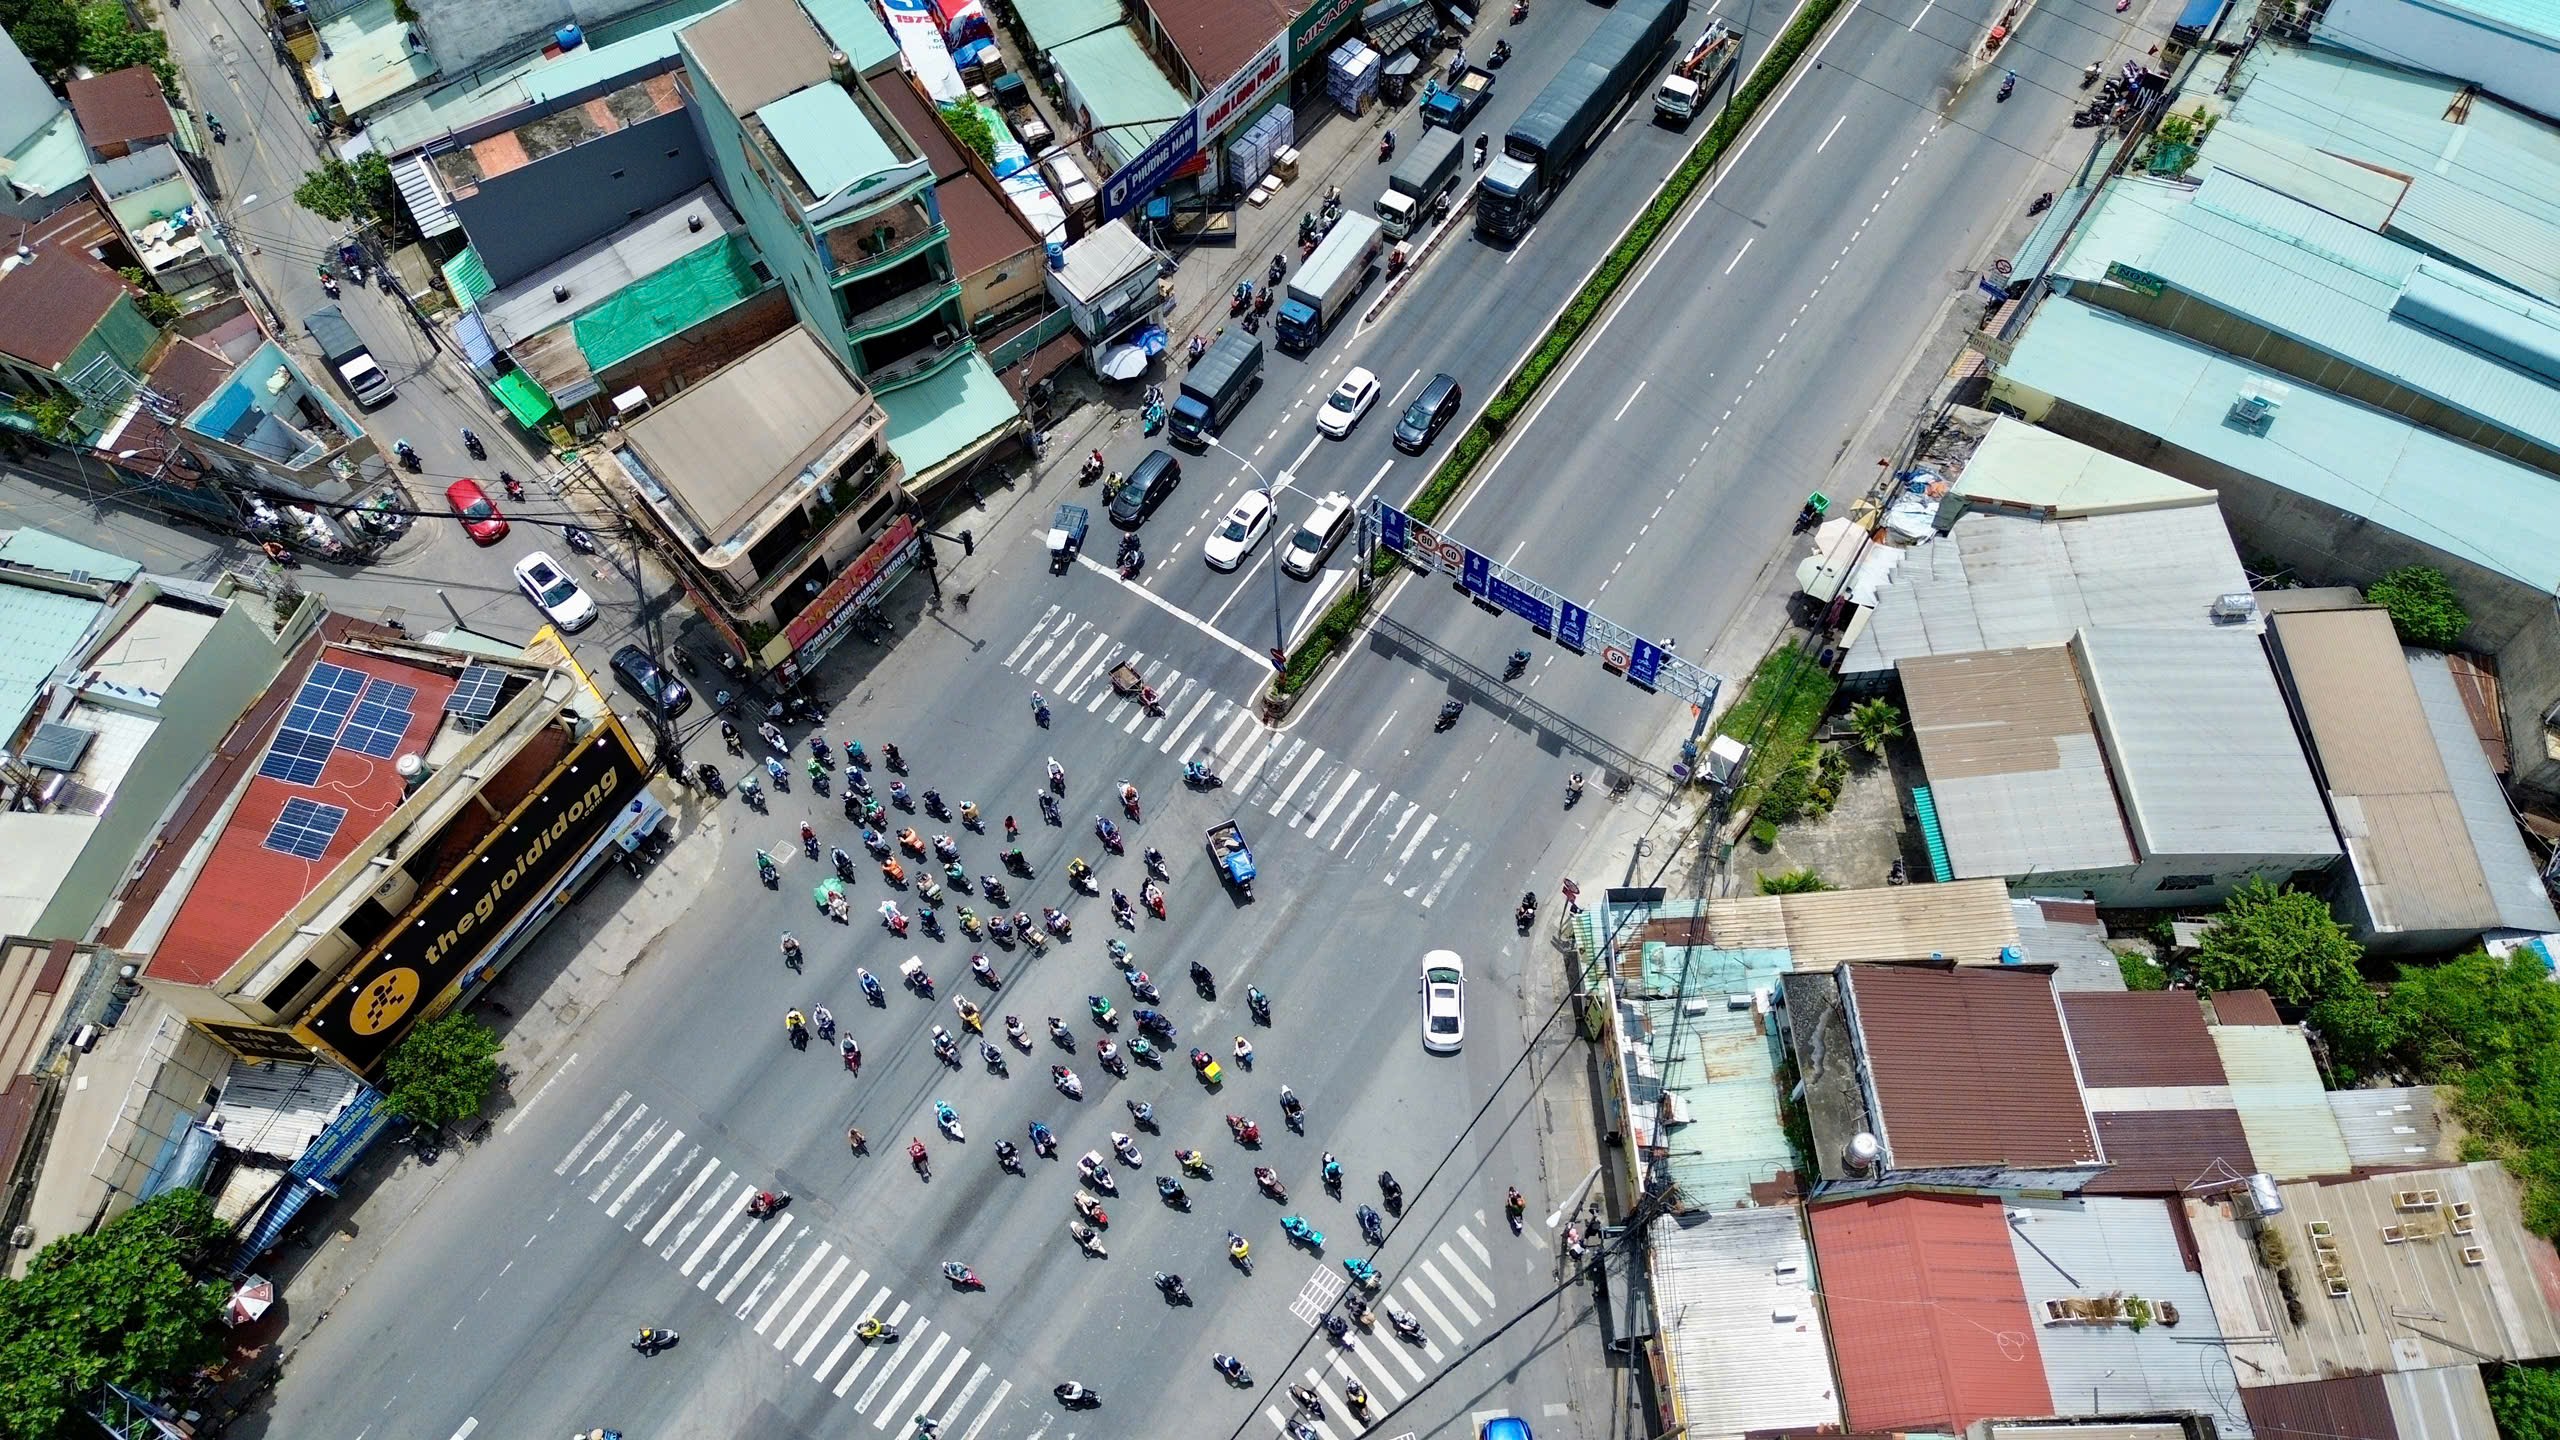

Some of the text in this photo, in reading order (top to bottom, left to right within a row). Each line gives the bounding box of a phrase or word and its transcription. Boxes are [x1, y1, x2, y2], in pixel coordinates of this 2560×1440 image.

[1171, 125, 1194, 154] NAM
[1421, 535, 1433, 547] 80
[1445, 549, 1457, 561] 60
[855, 573, 883, 605] QUANG
[883, 551, 908, 578] HƯNG
[1610, 652, 1623, 665] 50
[581, 796, 603, 820] .com
[424, 766, 618, 965] thegioididong
